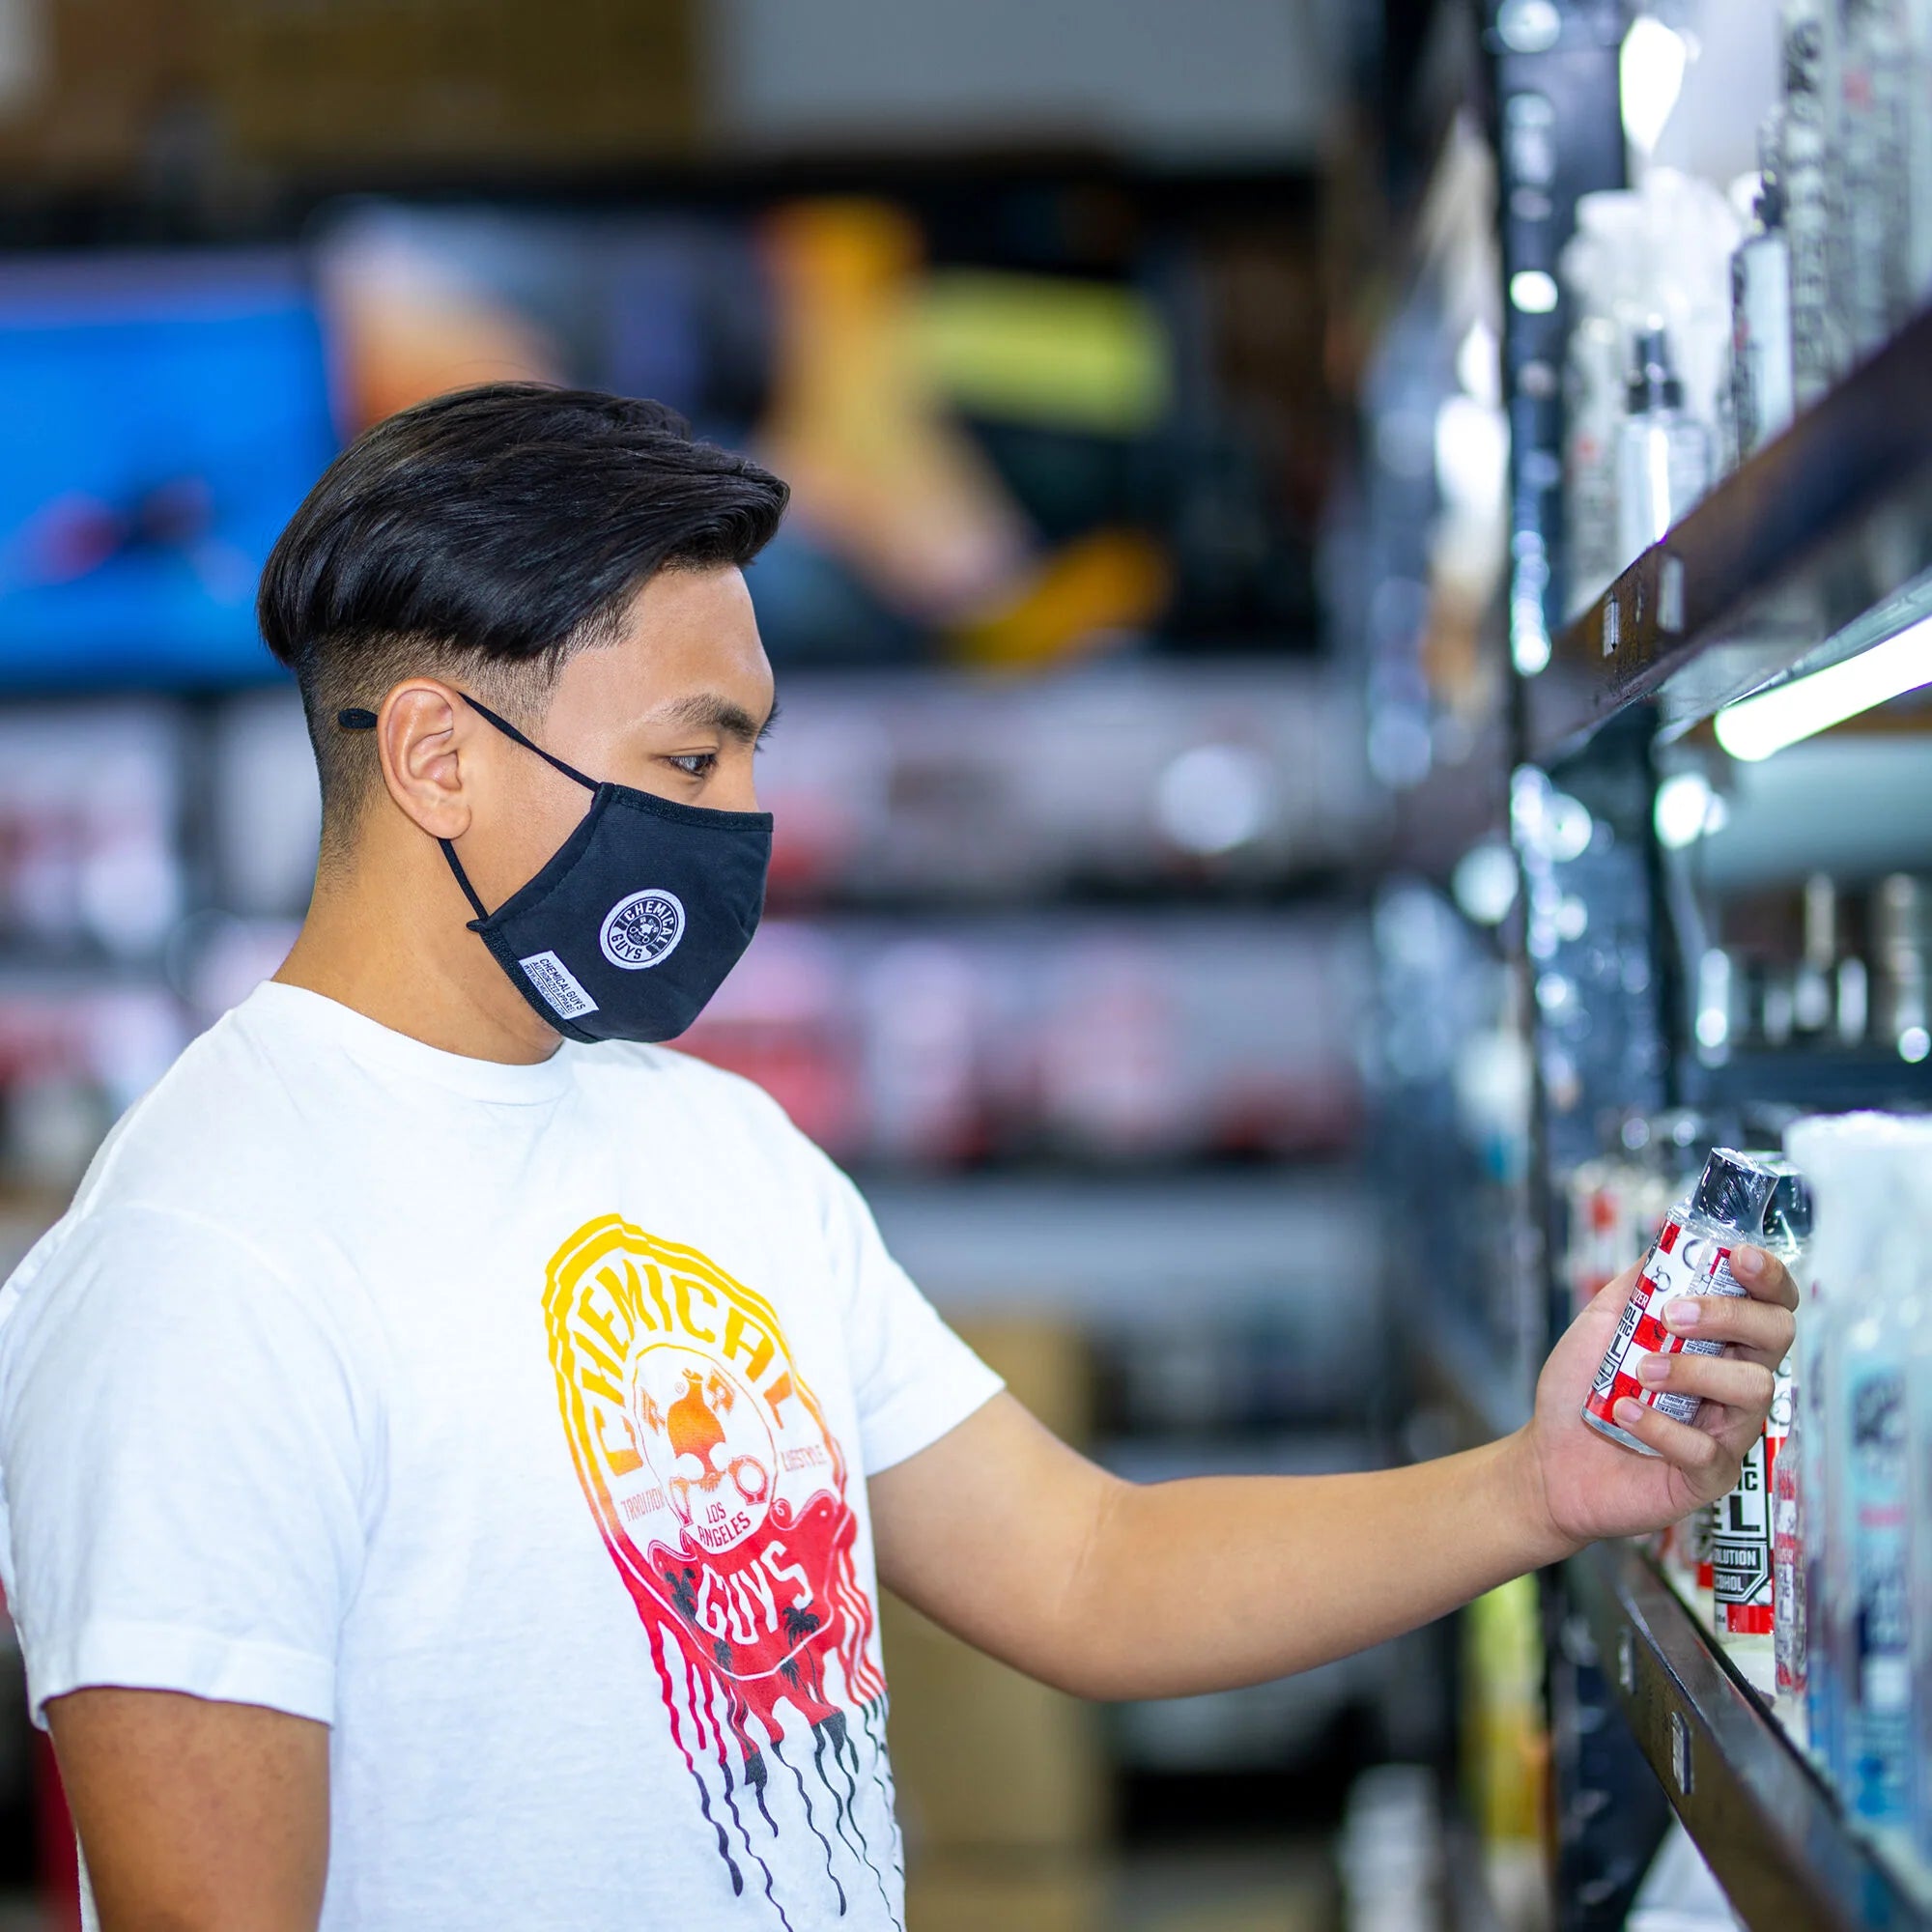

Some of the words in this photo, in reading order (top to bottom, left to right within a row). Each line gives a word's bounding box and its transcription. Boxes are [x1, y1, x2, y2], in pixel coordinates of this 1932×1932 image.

[624, 900, 674, 943] CHEMICAL
[611, 933, 643, 959] GUYS
[531, 962, 560, 993] AUTHORIZED
[557, 992, 577, 1013] APPAREL
[539, 958, 571, 992] CHEMICAL
[566, 990, 586, 1010] GUYS
[571, 1259, 795, 1477] CHEMICAL
[620, 1487, 666, 1522] TRADITION
[705, 1501, 727, 1524] LOS
[697, 1511, 752, 1548] ANGELES
[1715, 1548, 1756, 1566] OLUTION
[694, 1540, 814, 1645] GUYS
[1715, 1574, 1745, 1591] COHOL
